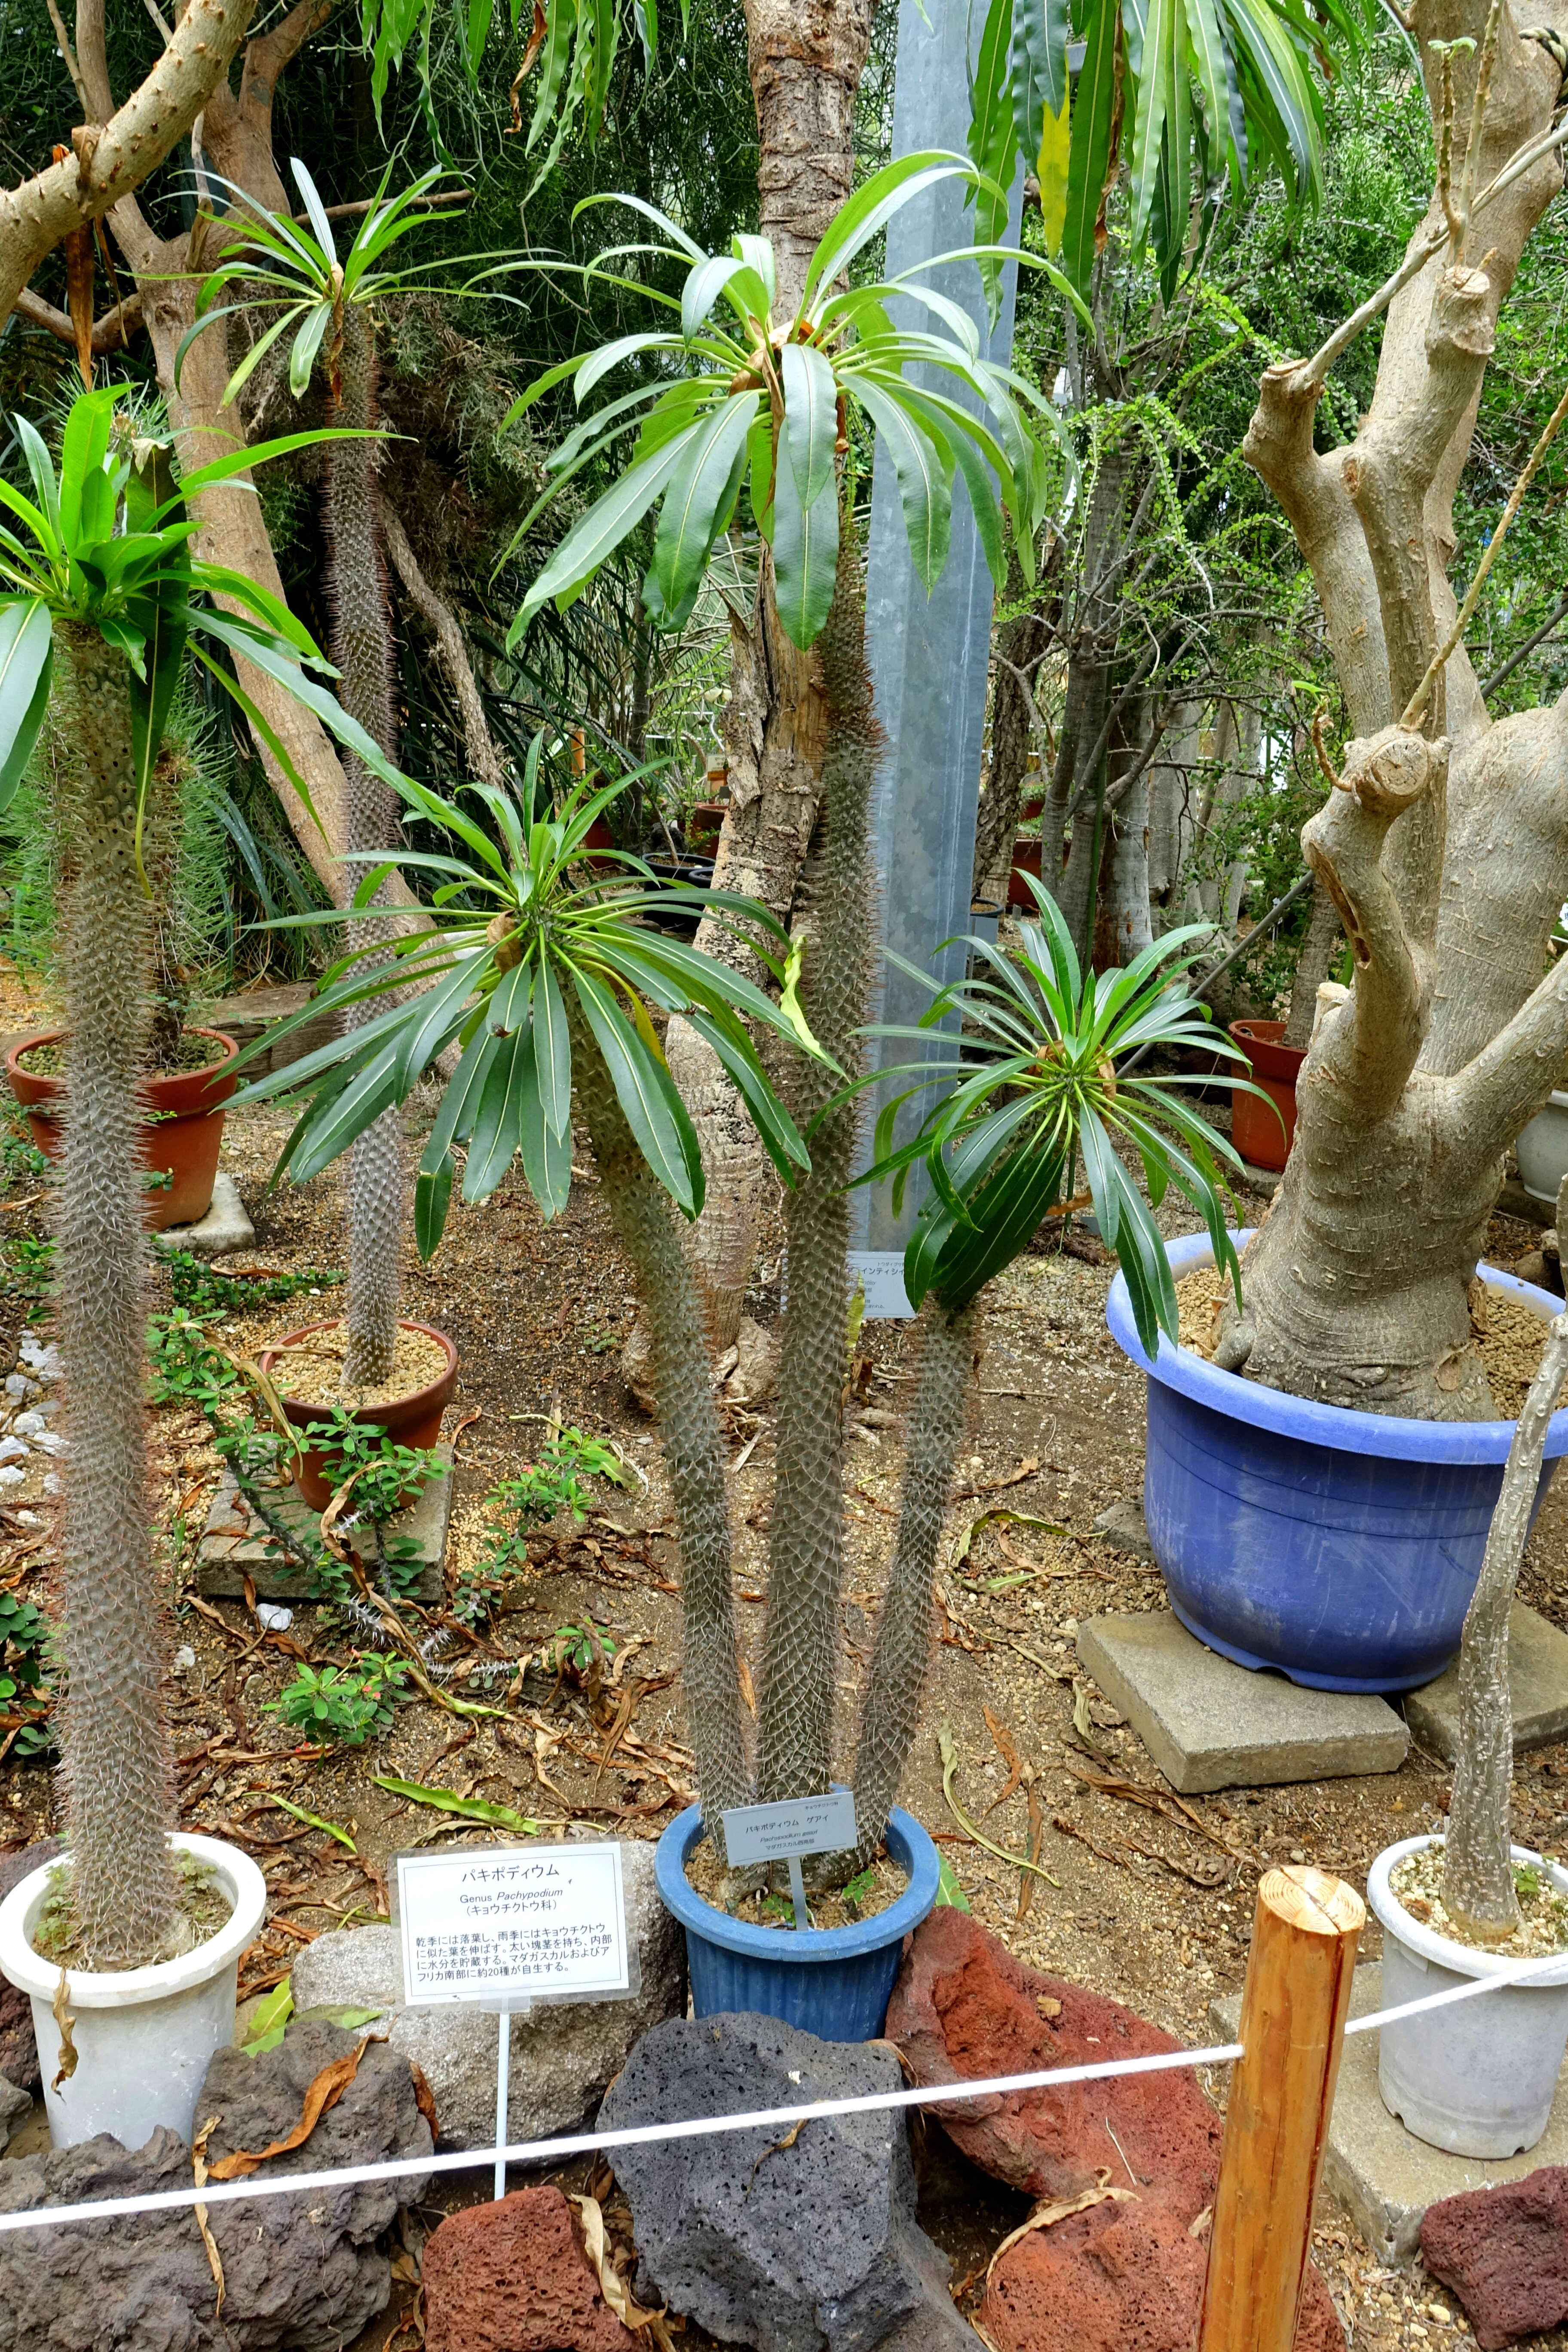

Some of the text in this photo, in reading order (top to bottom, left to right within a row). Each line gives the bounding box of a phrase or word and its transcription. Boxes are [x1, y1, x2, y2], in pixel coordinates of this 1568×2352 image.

[746, 1815, 828, 1833] パキポディウム ゲアイ
[760, 1833, 801, 1843] Pachypodium
[462, 1863, 560, 1883] パキポディウム
[460, 1888, 563, 1904] Genus Pachypodium
[415, 1923, 606, 1948] 乾季には落葉し、雨季にはキョウチクトウ
[416, 1934, 612, 1959] に似た葉を伸ばす。太い塊茎を持ち、内部
[417, 1945, 610, 1970] に水分を貯蔵する。マダガスカルおよびア
[417, 1961, 570, 1982] フリカ南部に約20種が自生する。
